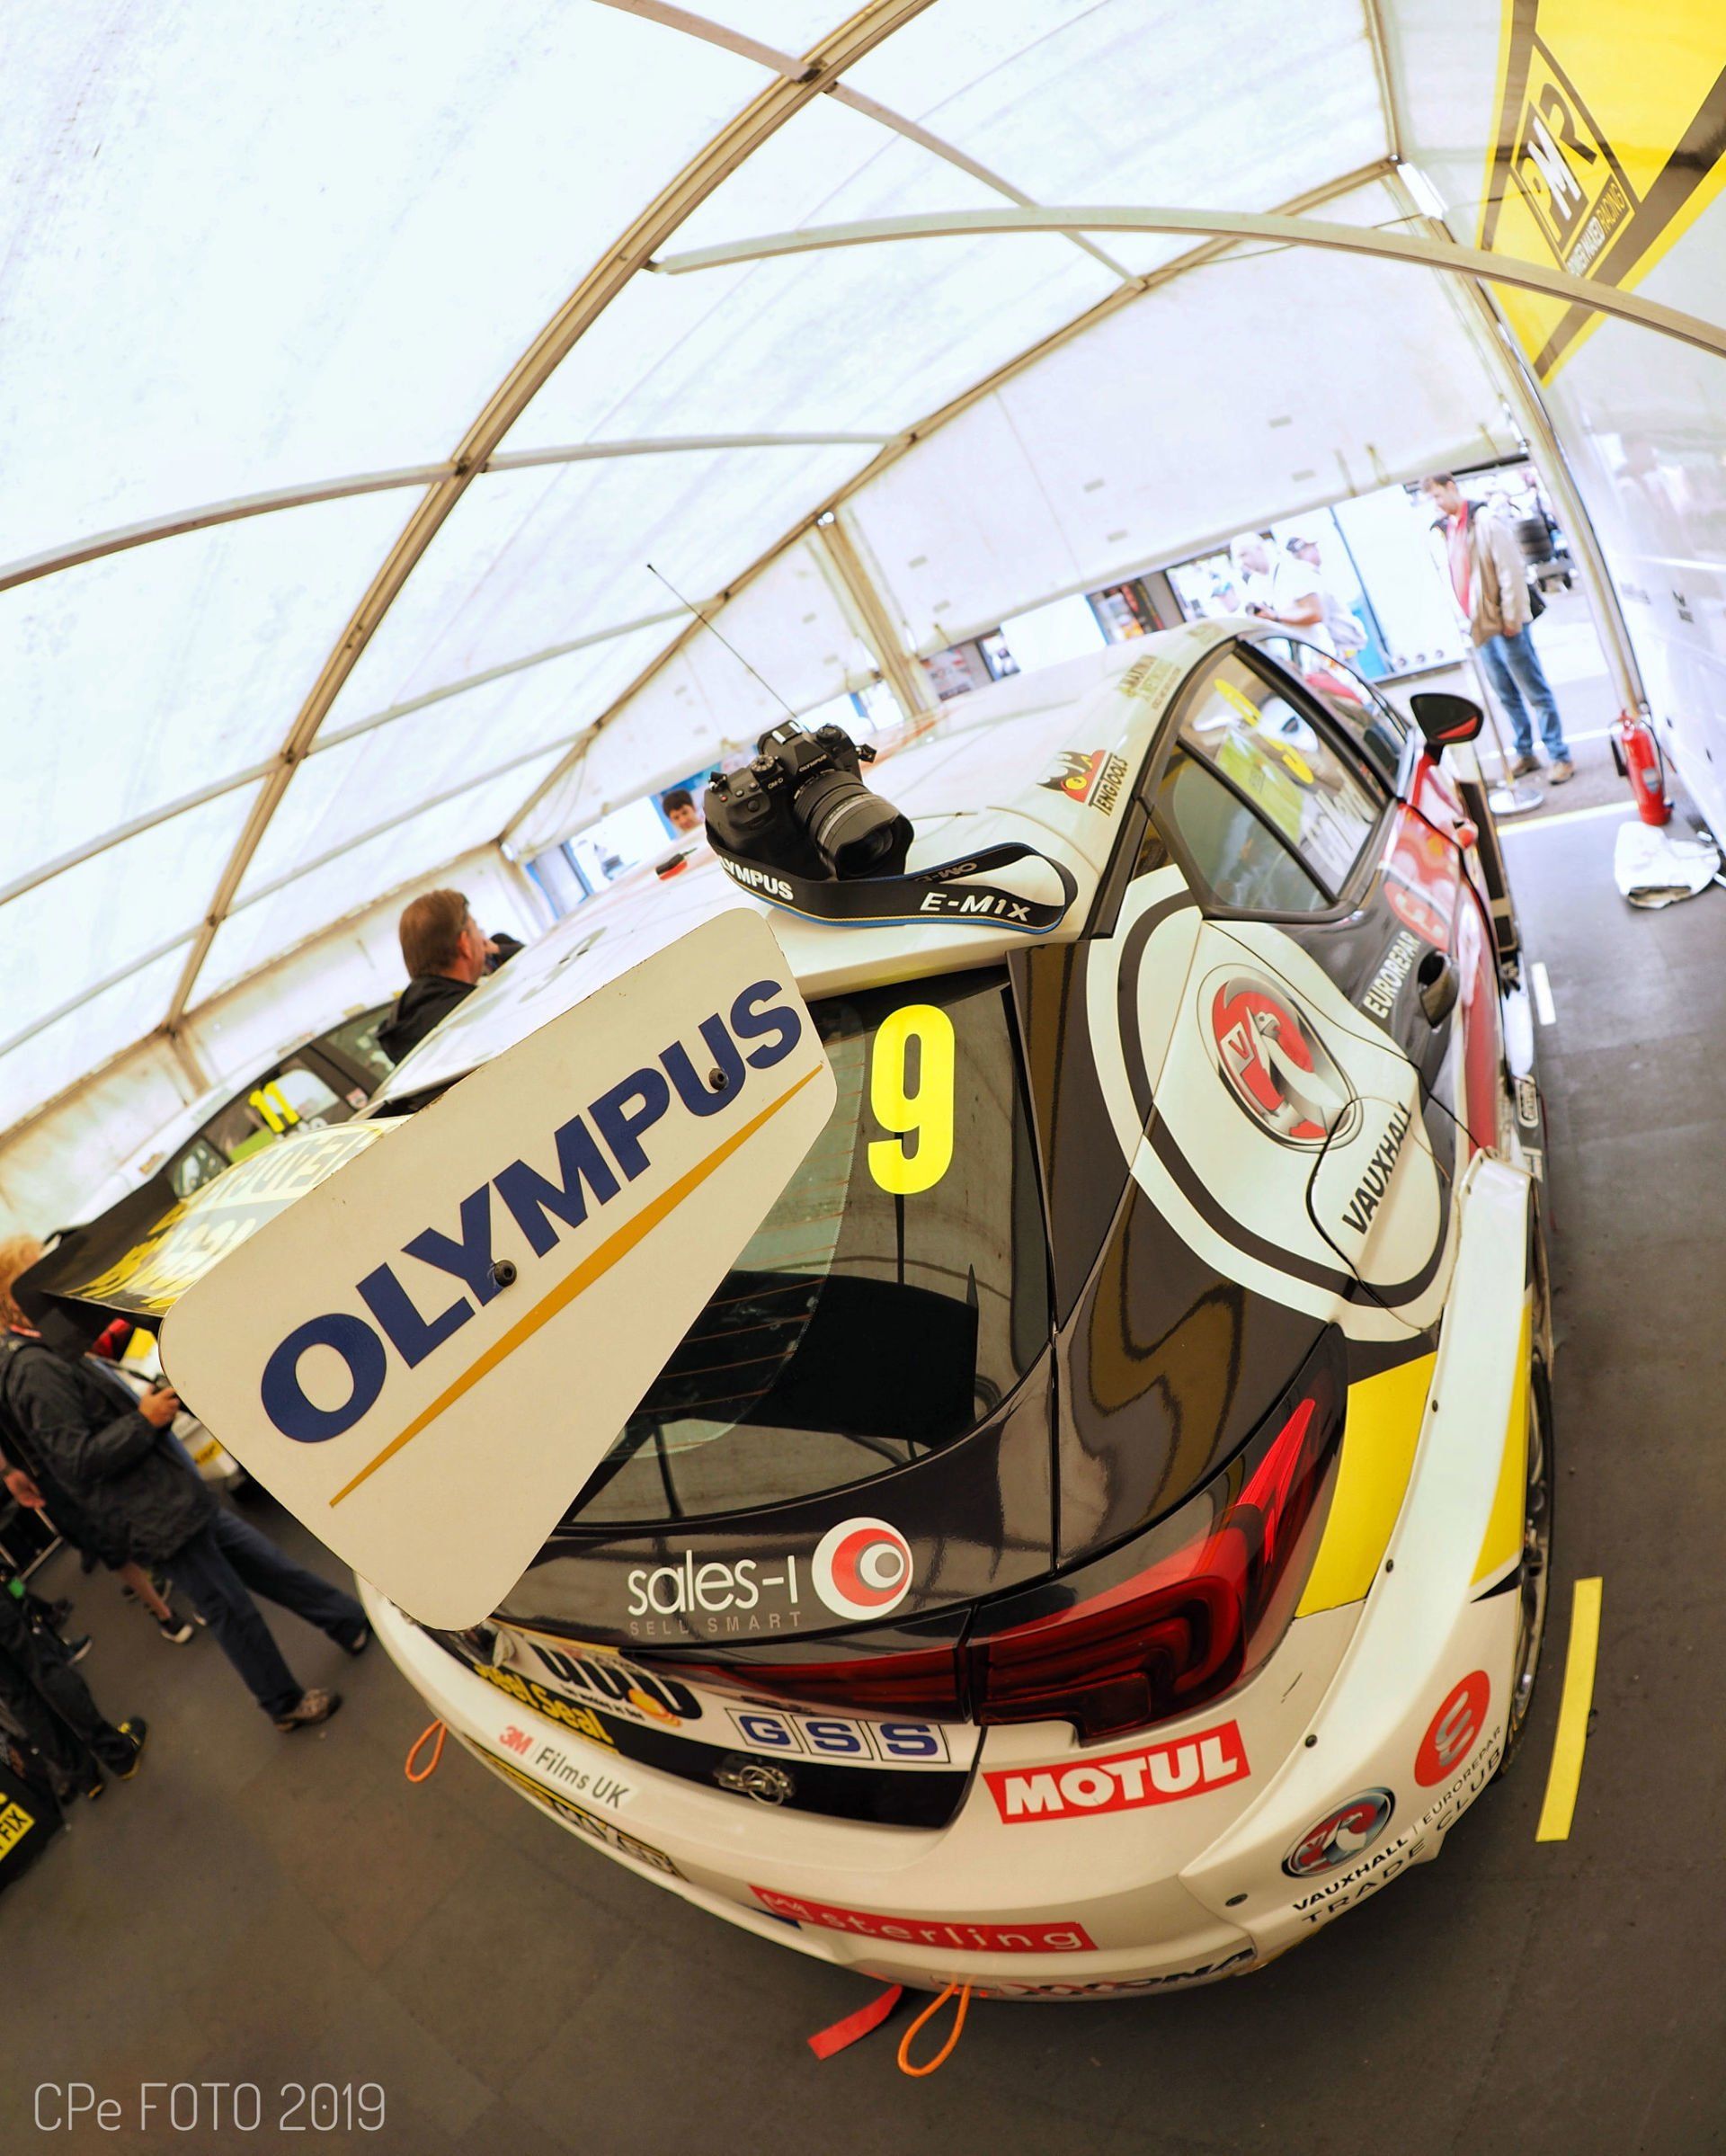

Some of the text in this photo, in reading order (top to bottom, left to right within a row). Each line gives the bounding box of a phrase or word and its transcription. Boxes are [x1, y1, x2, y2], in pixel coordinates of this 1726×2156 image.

[718, 855, 795, 901] LYMPUS
[920, 892, 1031, 922] E-M1X
[1362, 931, 1421, 1019] EUROREPAR
[248, 1081, 300, 1134] 11
[867, 1004, 955, 1194] 9
[1341, 1101, 1412, 1235] VAUXHALL
[261, 980, 803, 1443] OLYMPUS
[630, 1611, 801, 1637] SELL SMART
[500, 1725, 534, 1755] 3M
[536, 1746, 591, 1790] Films
[592, 1776, 629, 1809] UK
[739, 1713, 939, 1757] GSS
[1003, 1735, 1240, 1816] MOTUL
[1292, 1724, 1502, 1911] VAUXHALL EUROREPAR
[1301, 1748, 1502, 1925] TRADE CLUB
[820, 1911, 1083, 1950] sterling
